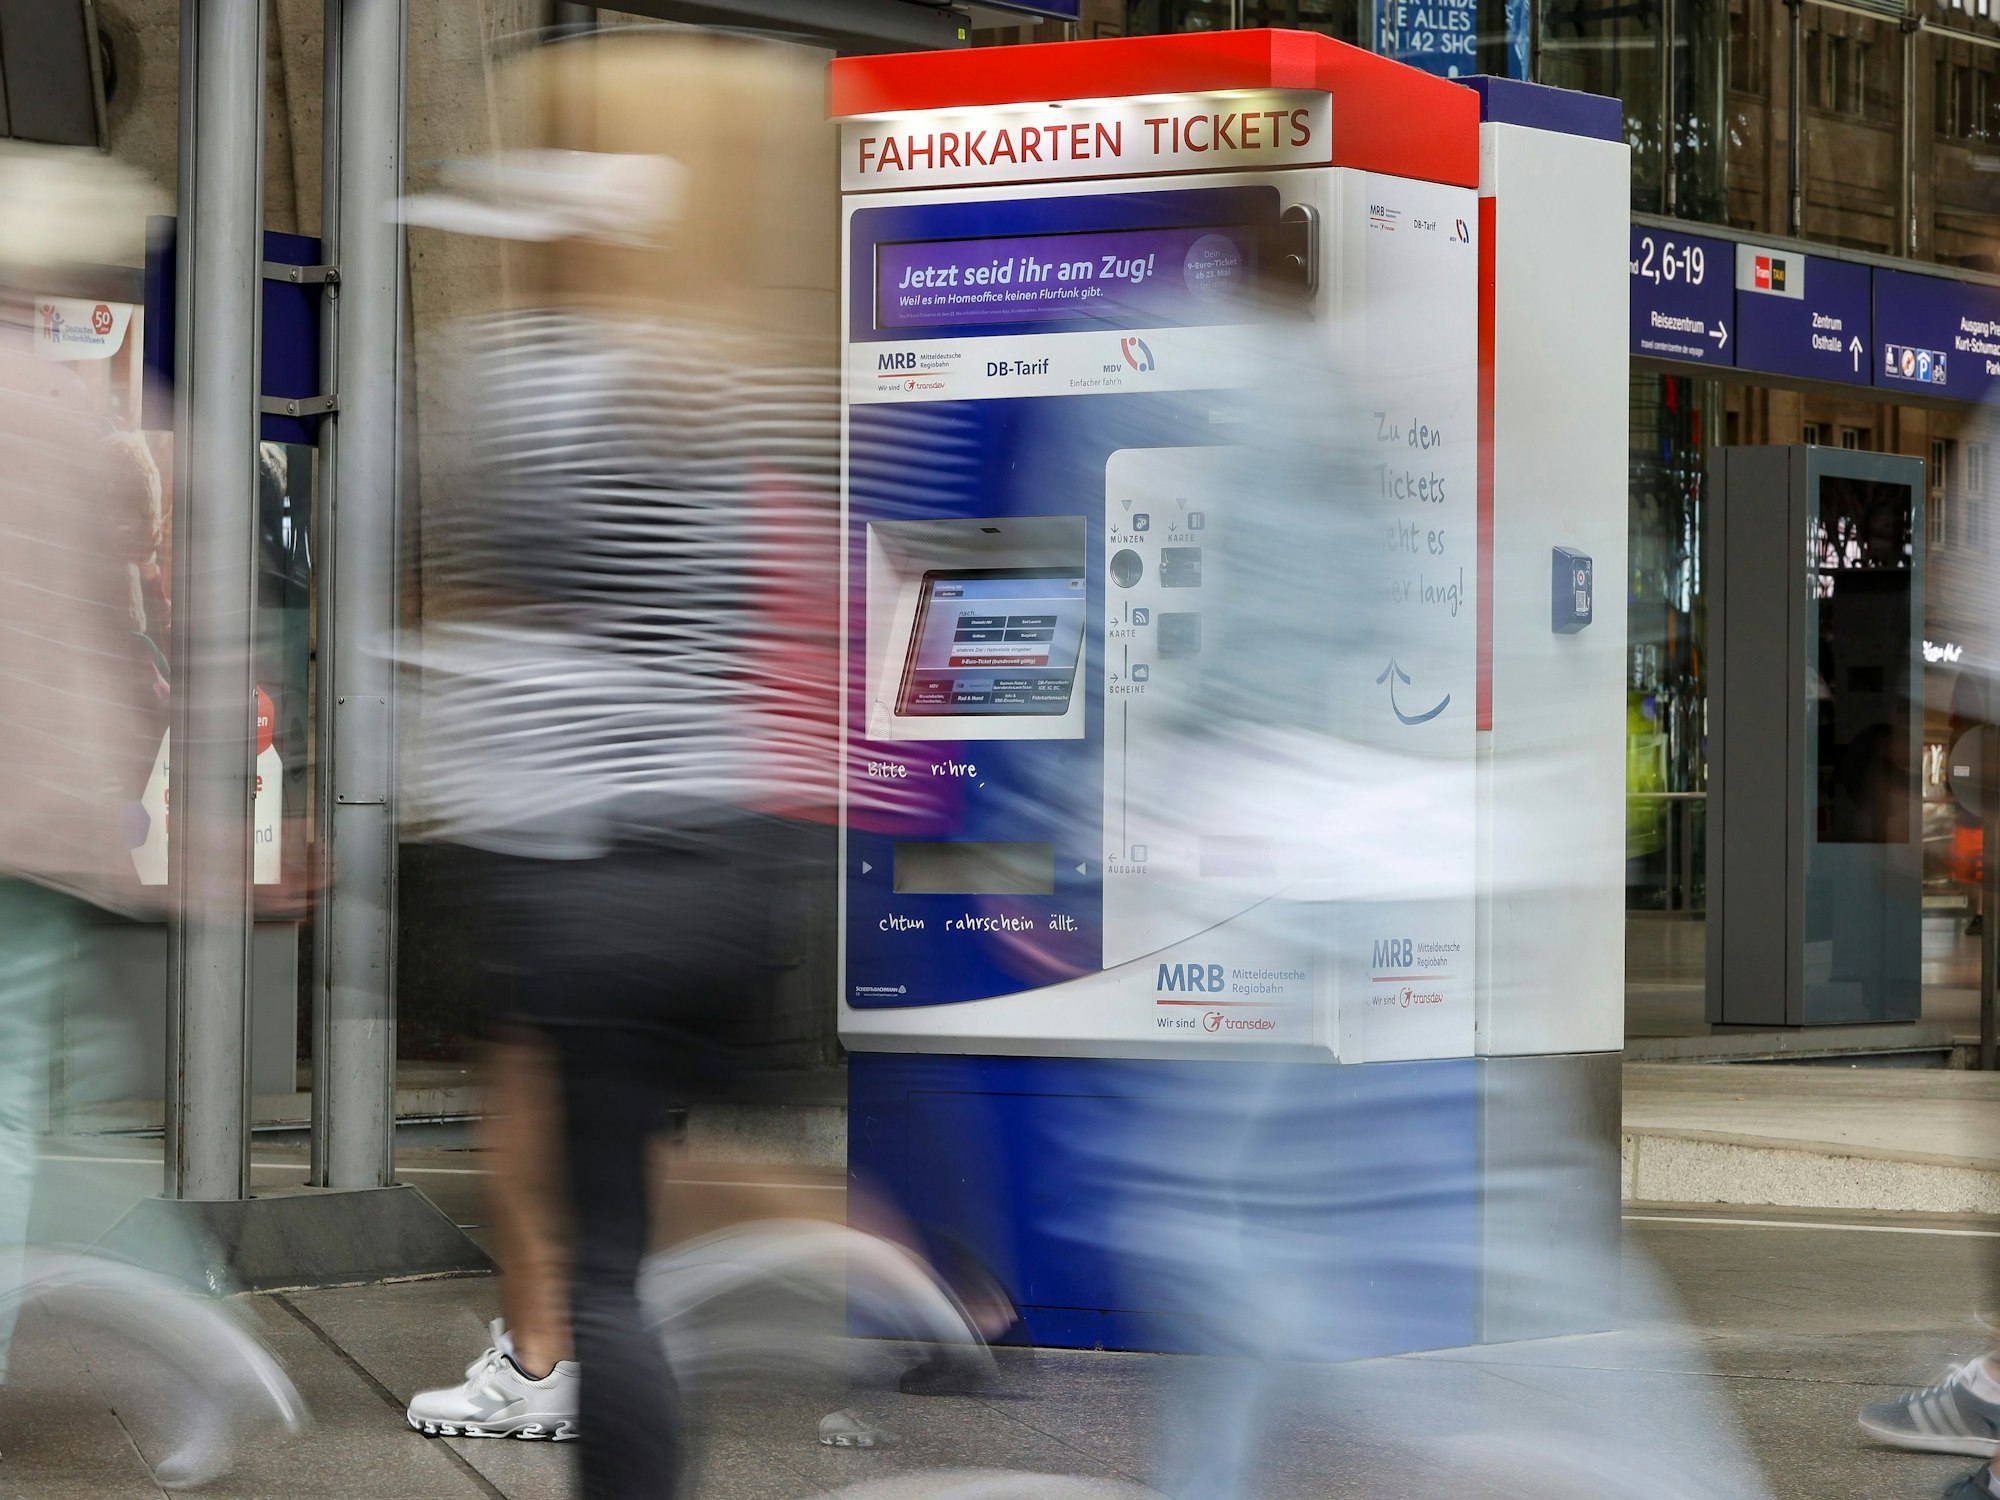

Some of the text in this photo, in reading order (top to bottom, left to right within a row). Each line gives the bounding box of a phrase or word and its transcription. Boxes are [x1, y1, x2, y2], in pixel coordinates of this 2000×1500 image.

[1414, 8, 1471, 31] ALLES
[859, 109, 1311, 174] FAHRKARTEN TICKETS
[1370, 204, 1385, 216] MRB
[1413, 219, 1436, 231] DB-Tarif
[1641, 236, 1705, 285] 2,6-19
[899, 253, 1155, 289] Jetzt seid ihr am Zug!
[900, 286, 1104, 306] Weil es im Homeoffice keinen Flurfunk gibt.
[95, 311, 110, 328] 50
[1650, 310, 1704, 334] Reisezentrum
[1812, 312, 1842, 331] Zentrum
[1960, 316, 1989, 338] Ausgang
[1812, 334, 1842, 352] Osthalle
[878, 352, 917, 370] MRB
[920, 352, 961, 360] Mitteldeutsche
[986, 358, 1049, 377] DB-Tarif
[1103, 364, 1122, 373] MDV
[917, 381, 945, 389] transdev
[1070, 378, 1101, 387] Einfacher
[1374, 412, 1440, 450] Zu den
[1374, 463, 1445, 503] Tickets
[1110, 532, 1145, 543] MÜNZEN
[1168, 533, 1195, 542] KARTE
[1384, 518, 1444, 555] eht es
[1420, 566, 1463, 618] lang!
[1109, 629, 1136, 638] KARTE
[1109, 685, 1145, 694] SCHEINE
[867, 761, 908, 778] Bitte
[1108, 865, 1147, 874] AUSGABE
[1372, 938, 1413, 968] MRB
[1417, 941, 1461, 953] Mitteldeutsche
[1417, 956, 1448, 969] Regiobahn
[1156, 963, 1225, 993] MRB
[1232, 969, 1306, 980] Mitteldeutsche
[1232, 983, 1283, 995] Regiobahn
[1372, 992, 1443, 1005] Wir sind transdev
[1157, 1018, 1276, 1030] Wir sind transdev
